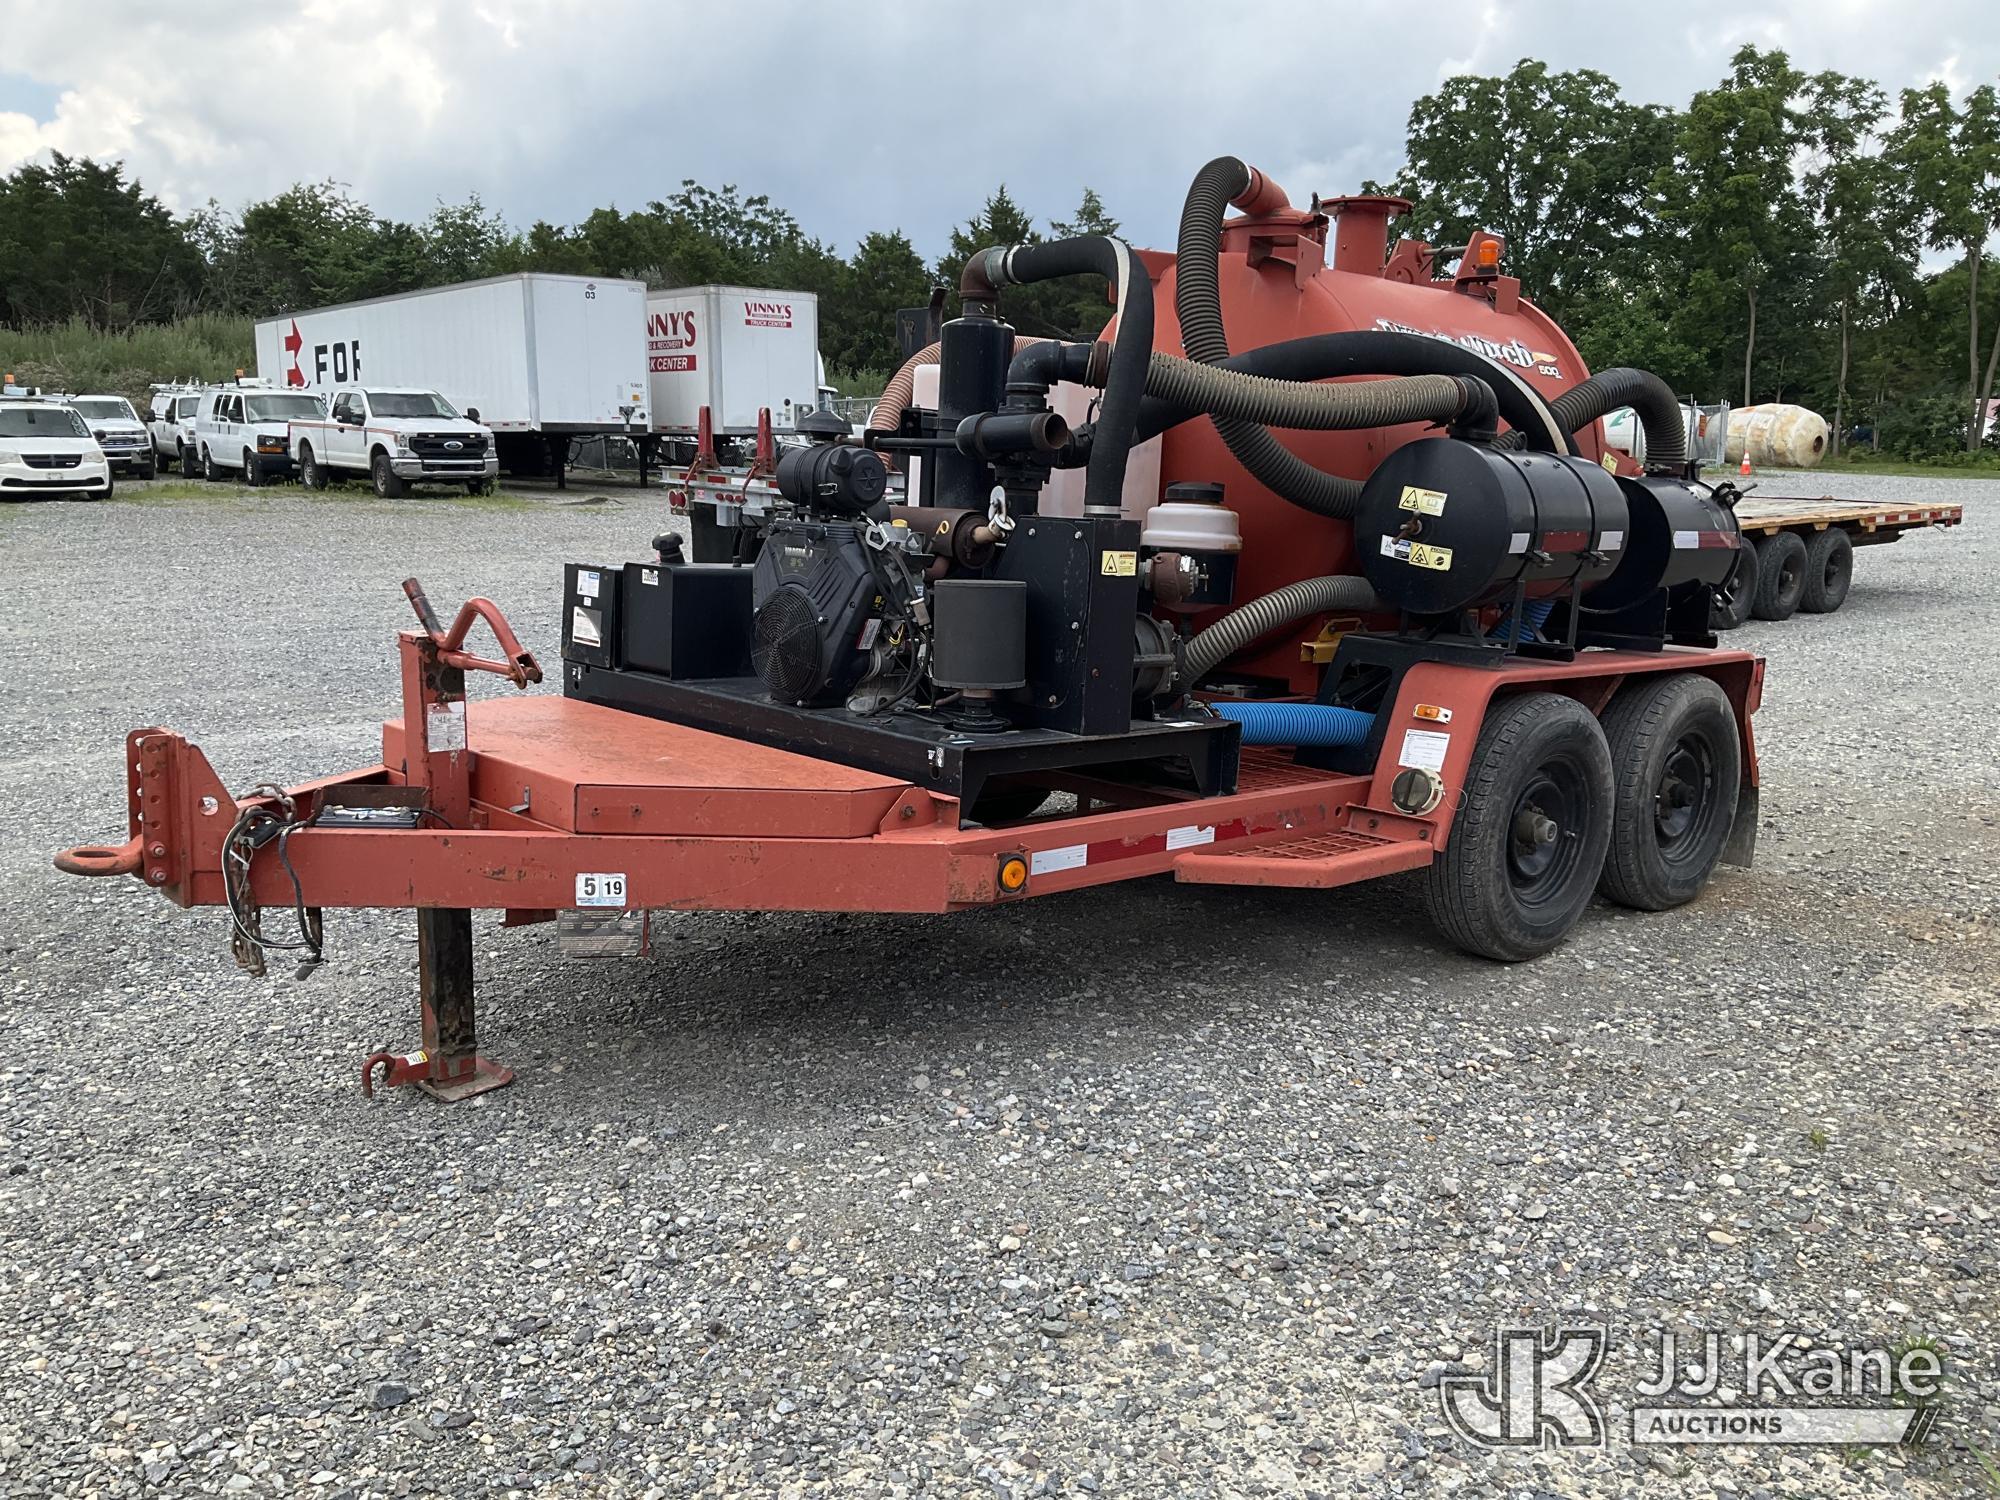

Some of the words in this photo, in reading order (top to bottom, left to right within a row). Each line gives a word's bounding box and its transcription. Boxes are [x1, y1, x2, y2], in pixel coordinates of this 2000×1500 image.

[585, 291, 596, 300] 03
[744, 302, 792, 319] VINNY'S
[657, 357, 688, 370] CENTER
[584, 877, 596, 896] 5
[604, 881, 623, 895] 19
